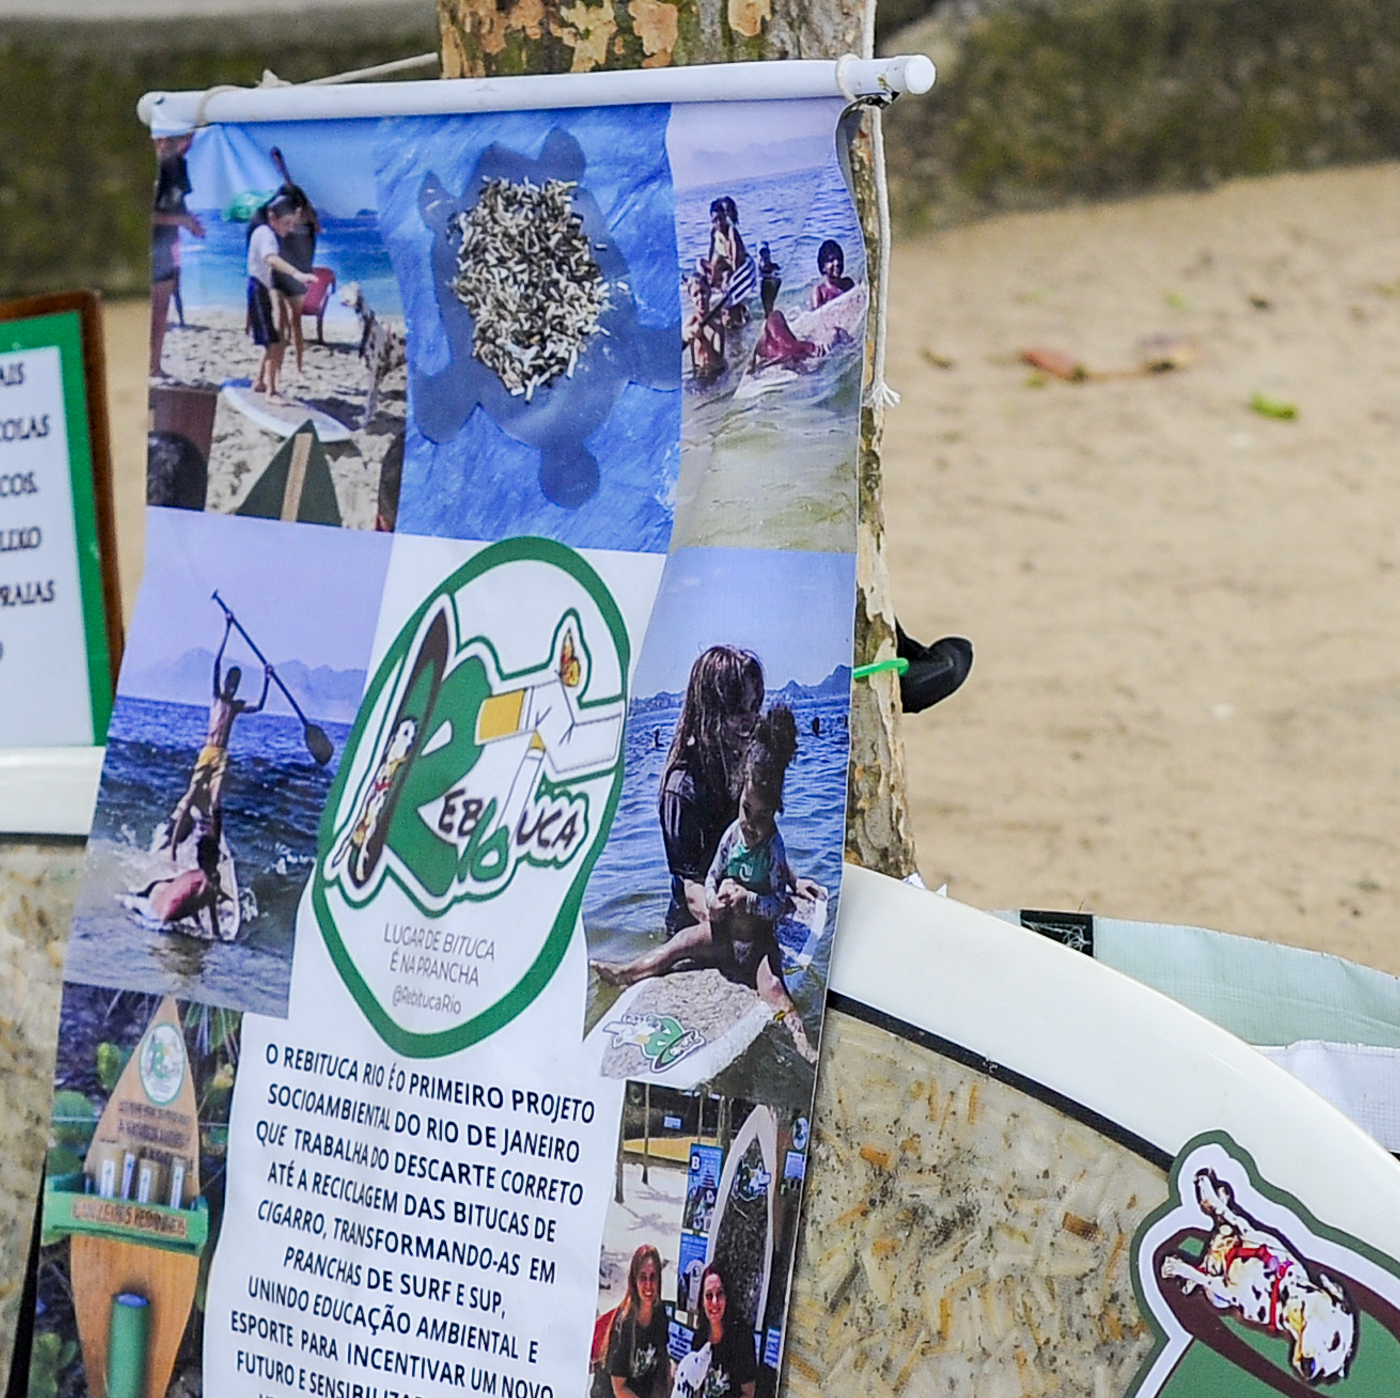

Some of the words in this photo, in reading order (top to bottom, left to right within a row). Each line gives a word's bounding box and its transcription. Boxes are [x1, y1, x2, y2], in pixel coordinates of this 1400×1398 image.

[390, 948, 398, 972] É
[400, 953, 415, 974] NA
[416, 956, 479, 986] PRANCHA
[425, 929, 441, 951] DE
[443, 933, 495, 961] BITUCA
[392, 985, 461, 1014] @RebitucaRio
[265, 1043, 278, 1064] O
[283, 1046, 359, 1081] REBITUCA
[363, 1062, 384, 1087] RIO
[388, 1062, 396, 1091] É
[396, 1070, 405, 1092] O
[409, 1073, 504, 1109] PRIMEIRO
[512, 1089, 595, 1124] PROJETO
[267, 1083, 391, 1131] SOCIOAMBIENTAL
[394, 1111, 420, 1136] DO
[426, 1117, 459, 1143] RIO
[467, 1124, 497, 1148] DE
[501, 1128, 580, 1163] JANEIRO
[256, 1120, 287, 1148] QUE
[294, 1128, 368, 1167] TRABALHA
[371, 1149, 389, 1171] DO
[394, 1153, 496, 1190] DESCARTE
[501, 1170, 584, 1206] CORRETO
[267, 1160, 295, 1188] ATÉ
[298, 1168, 308, 1191] A
[312, 1172, 398, 1214] RECICLAGEM
[404, 1194, 446, 1220] DAS
[454, 1201, 529, 1237] BITUCAS
[534, 1216, 557, 1243] DE
[257, 1199, 327, 1240] CIGARRO,
[333, 1217, 521, 1276] TRANSFORMANDO-AS
[530, 1258, 556, 1284] EM
[248, 1275, 310, 1312] UNINDO
[313, 1293, 411, 1336] EDUCAÇÃO
[416, 1316, 519, 1360] AMBIENTAL
[528, 1341, 538, 1364] E
[284, 1246, 362, 1286] PRANCHAS
[367, 1268, 393, 1293] DE
[400, 1274, 452, 1302] SURF
[456, 1284, 465, 1305] E
[469, 1287, 505, 1320] SUP,
[231, 1310, 294, 1347] ESPORTE
[301, 1330, 338, 1361] PARA
[347, 1343, 465, 1387] INCENTIVAR
[471, 1367, 497, 1396] UM
[236, 1350, 295, 1386] FUTURO
[299, 1368, 306, 1390] E
